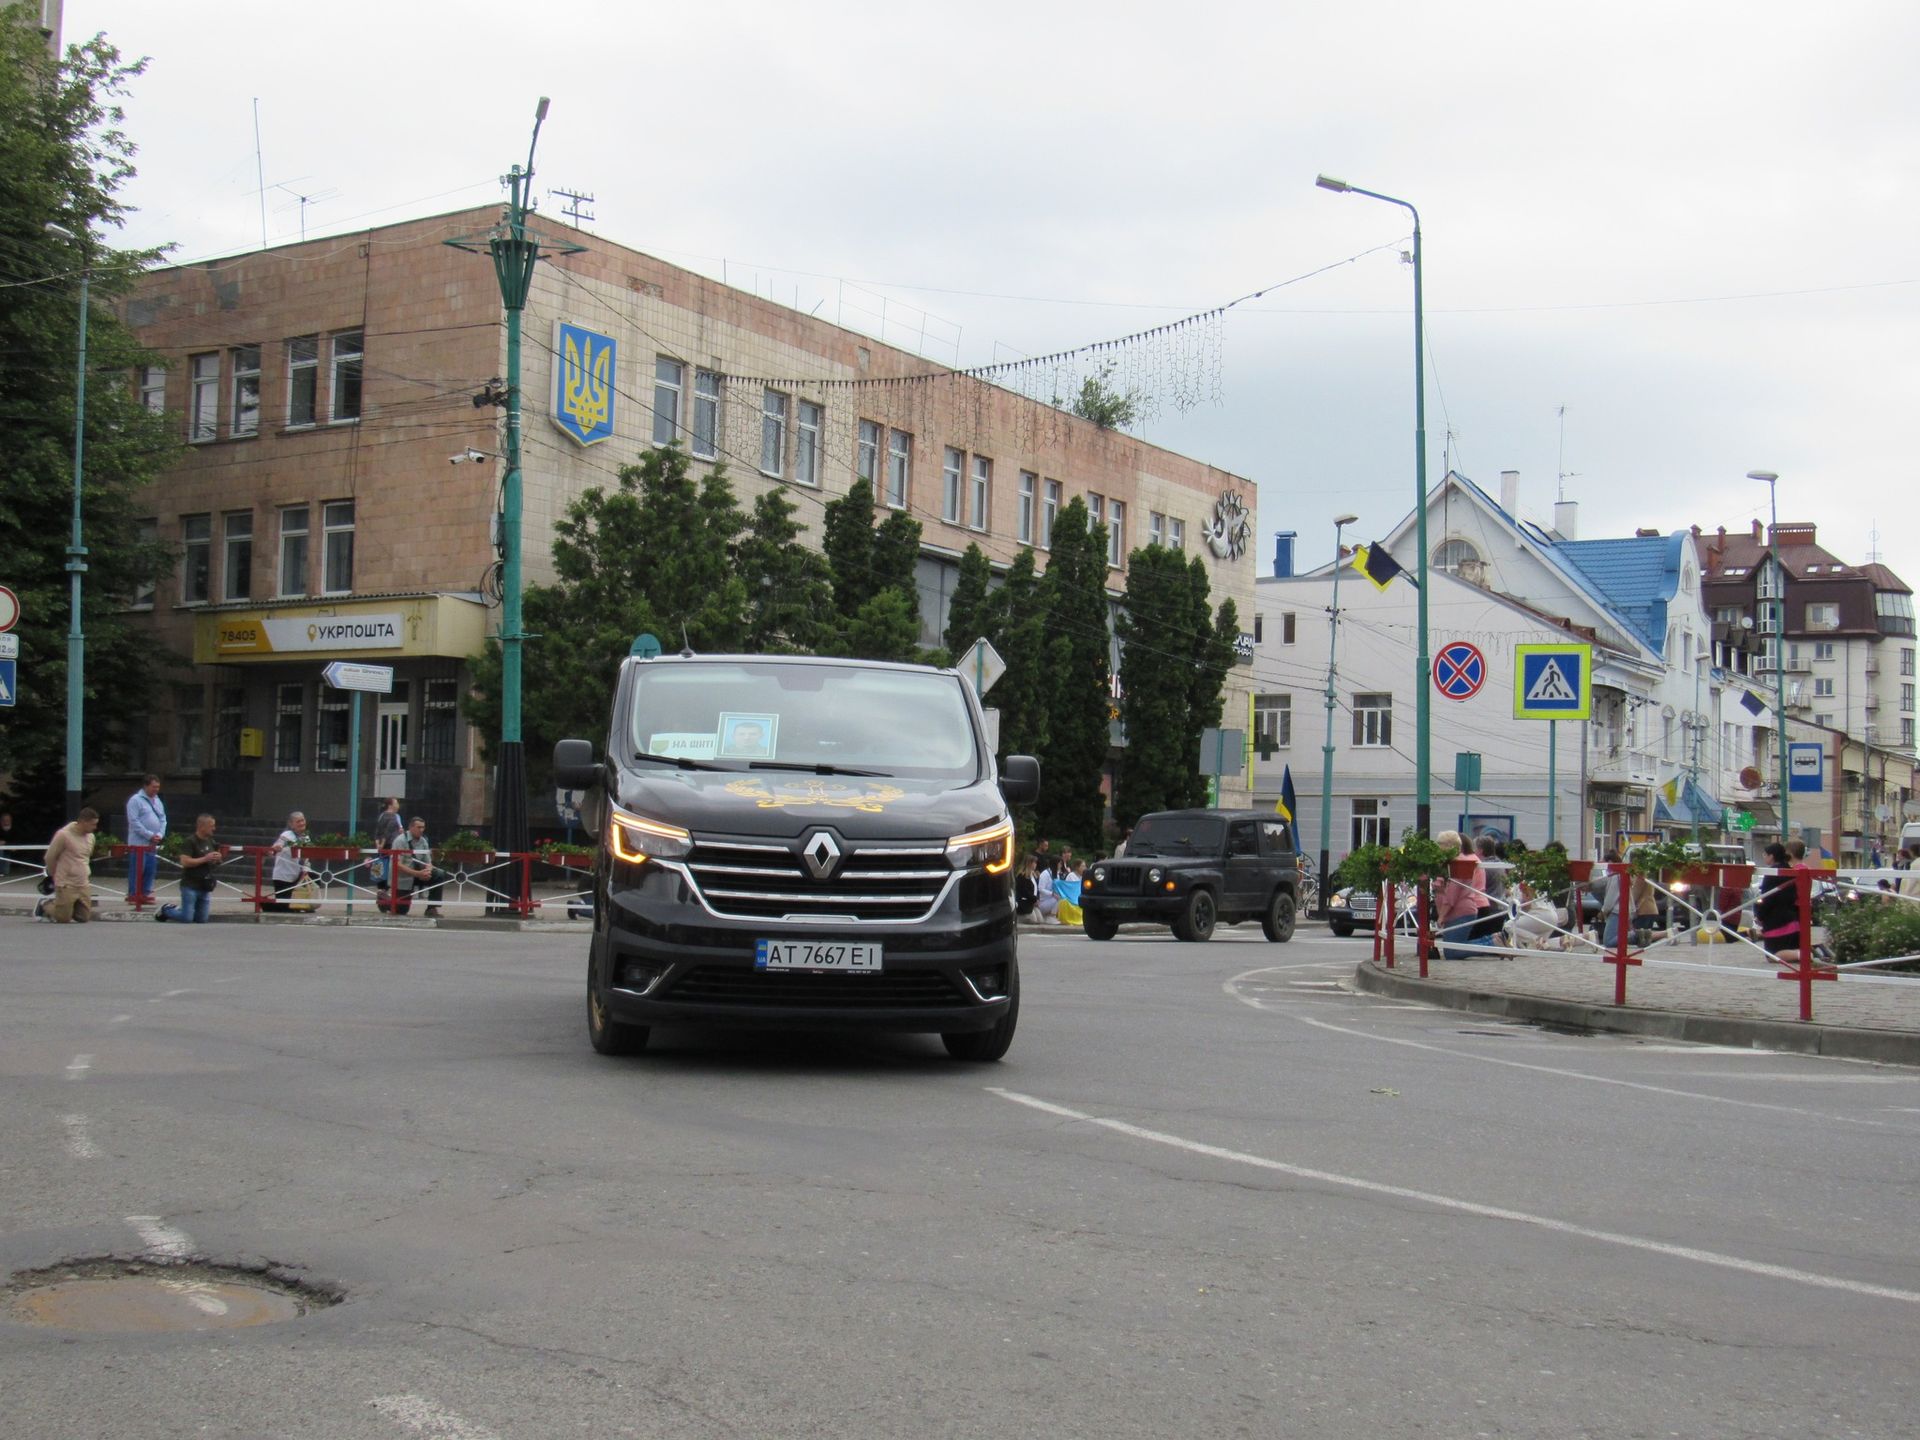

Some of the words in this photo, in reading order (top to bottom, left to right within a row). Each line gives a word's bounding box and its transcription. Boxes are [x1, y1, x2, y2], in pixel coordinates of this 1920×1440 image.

[221, 630, 256, 642] 78405
[318, 623, 394, 640] УКРПОШТА
[672, 740, 687, 749] НА
[689, 740, 714, 749] ЩИТІ
[769, 945, 797, 964] AT
[803, 945, 846, 965] 7667
[851, 946, 873, 966] EI
